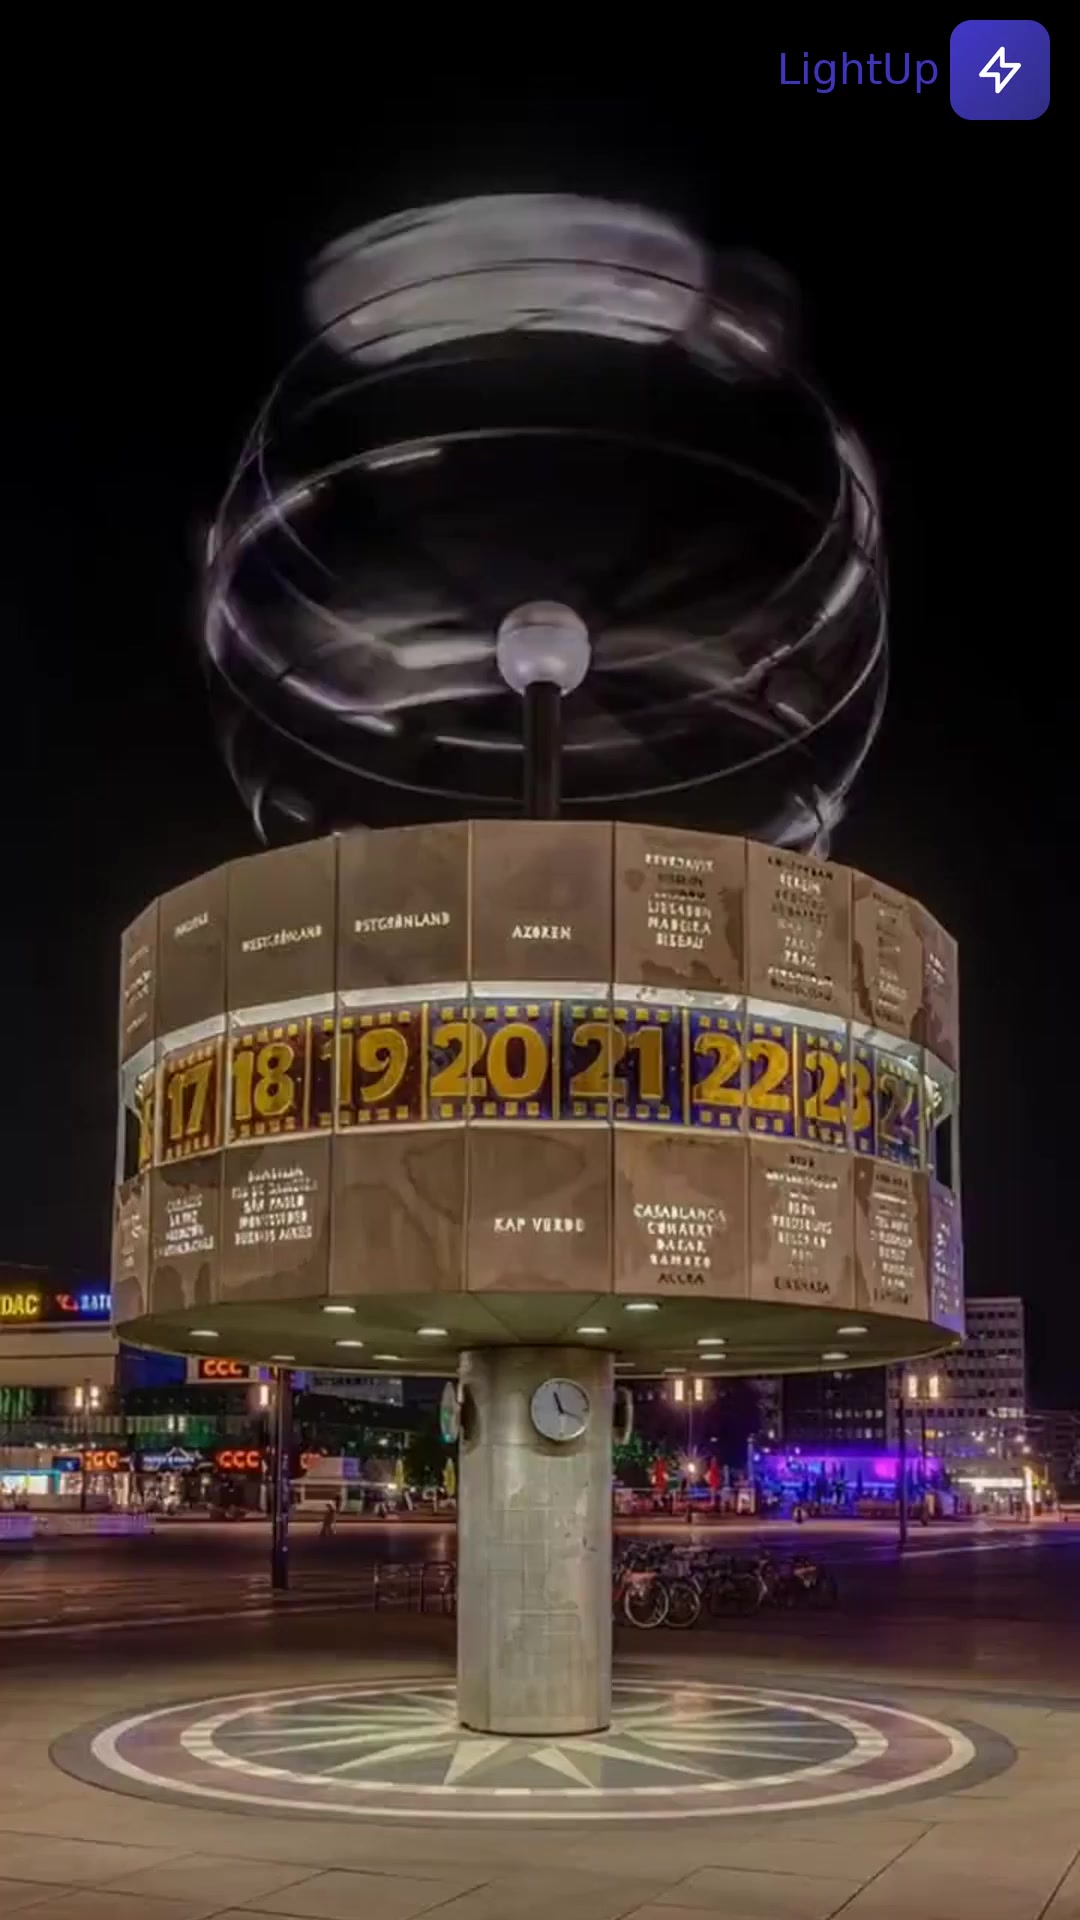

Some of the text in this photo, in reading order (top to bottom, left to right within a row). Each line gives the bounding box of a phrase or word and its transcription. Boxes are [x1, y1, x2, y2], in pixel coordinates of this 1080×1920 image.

[512, 924, 572, 941] AZOREN
[232, 1042, 295, 1121] 18
[320, 1027, 408, 1106] 19
[430, 1022, 547, 1098] 20
[570, 1022, 663, 1100] 21
[693, 1032, 791, 1113] 22
[805, 1051, 871, 1132] 23
[168, 1059, 213, 1141] 17
[493, 1217, 526, 1233] KAP
[633, 1203, 727, 1223] CASABLANCA
[203, 1359, 243, 1377] CCC
[218, 1450, 261, 1469] CCC
